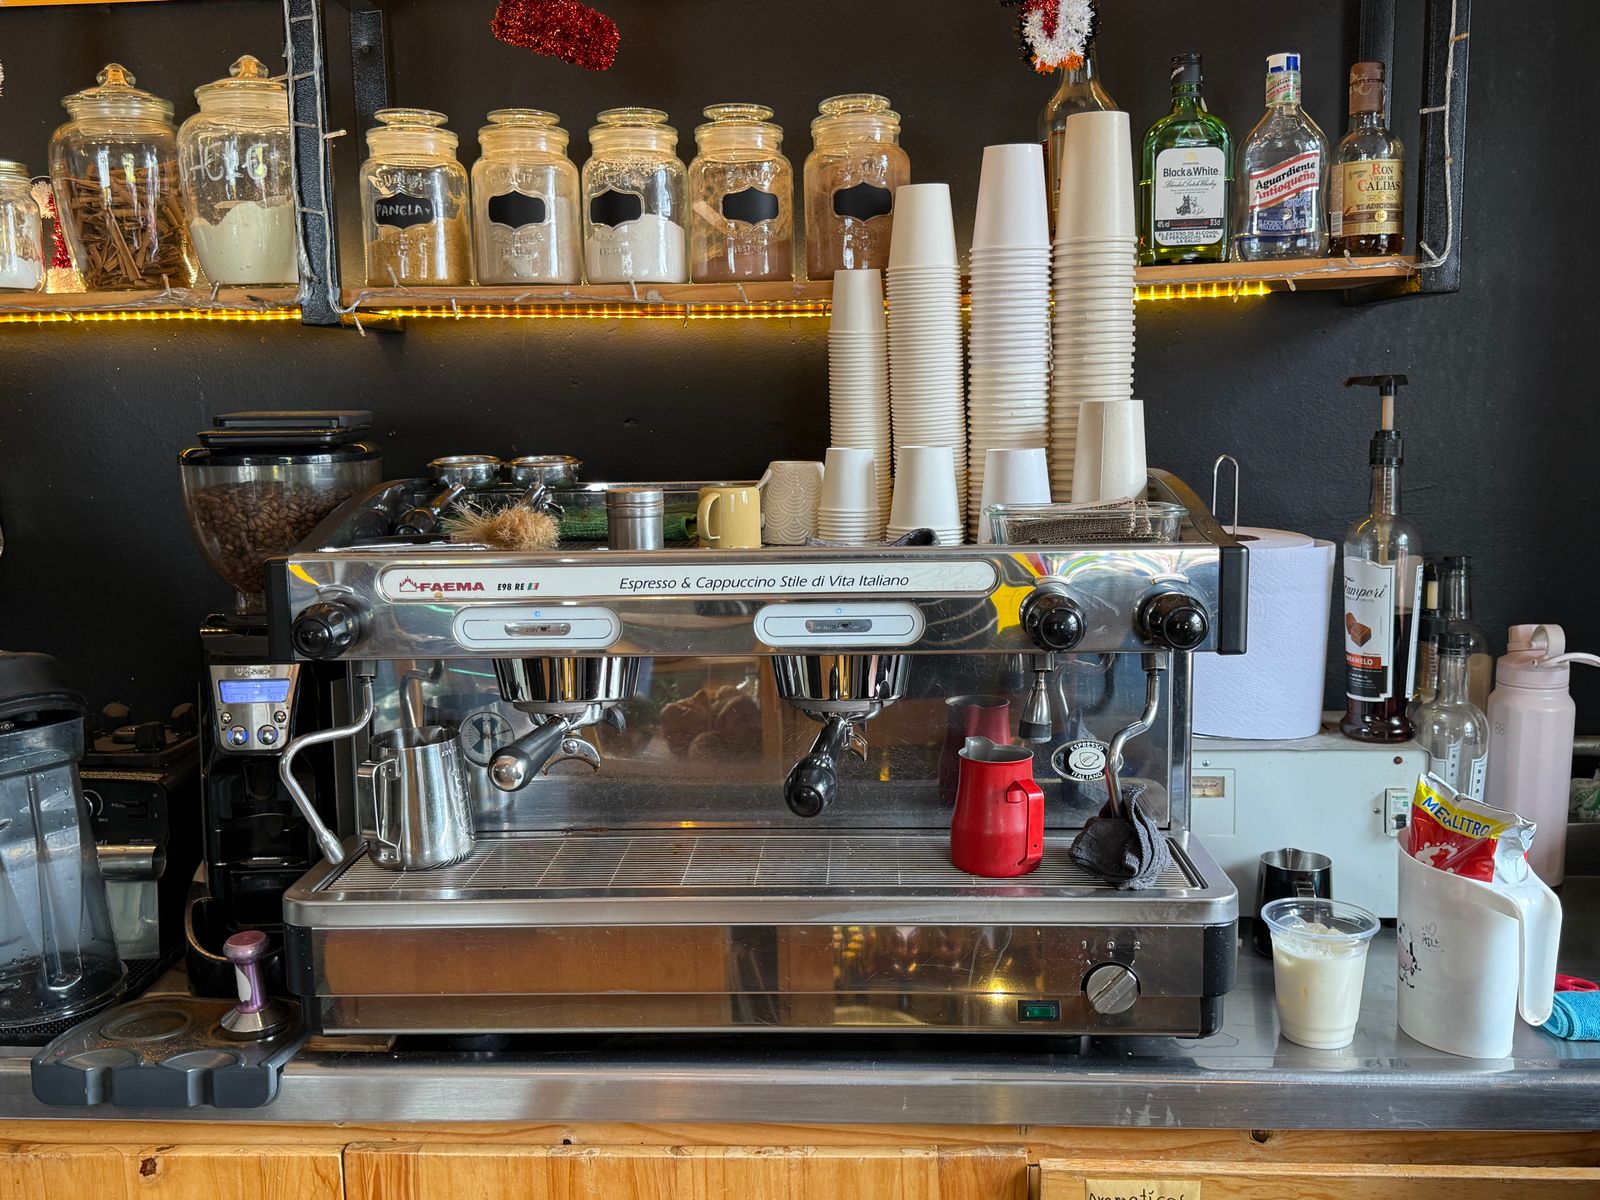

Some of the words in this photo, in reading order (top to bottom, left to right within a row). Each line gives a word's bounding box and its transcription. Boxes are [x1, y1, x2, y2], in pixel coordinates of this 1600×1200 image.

[1163, 166, 1219, 178] Black&White
[1256, 161, 1316, 190] Aguardiente
[1372, 164, 1394, 175] RON
[1254, 170, 1316, 200] Antioqueño
[1357, 180, 1401, 192] CALDAS
[375, 203, 424, 217] PANELA
[418, 581, 485, 592] FAEMA
[497, 582, 513, 592] E98
[514, 582, 525, 591] RE
[619, 577, 677, 592] Espresso
[680, 577, 691, 589] &
[695, 575, 776, 593] Cappuccino
[779, 575, 808, 588] Stile
[811, 575, 826, 588] di
[828, 575, 854, 588] Vita
[858, 574, 909, 588] Italiano
[1069, 741, 1104, 752] ESPRESSO
[1071, 771, 1103, 780] ITALIANO
